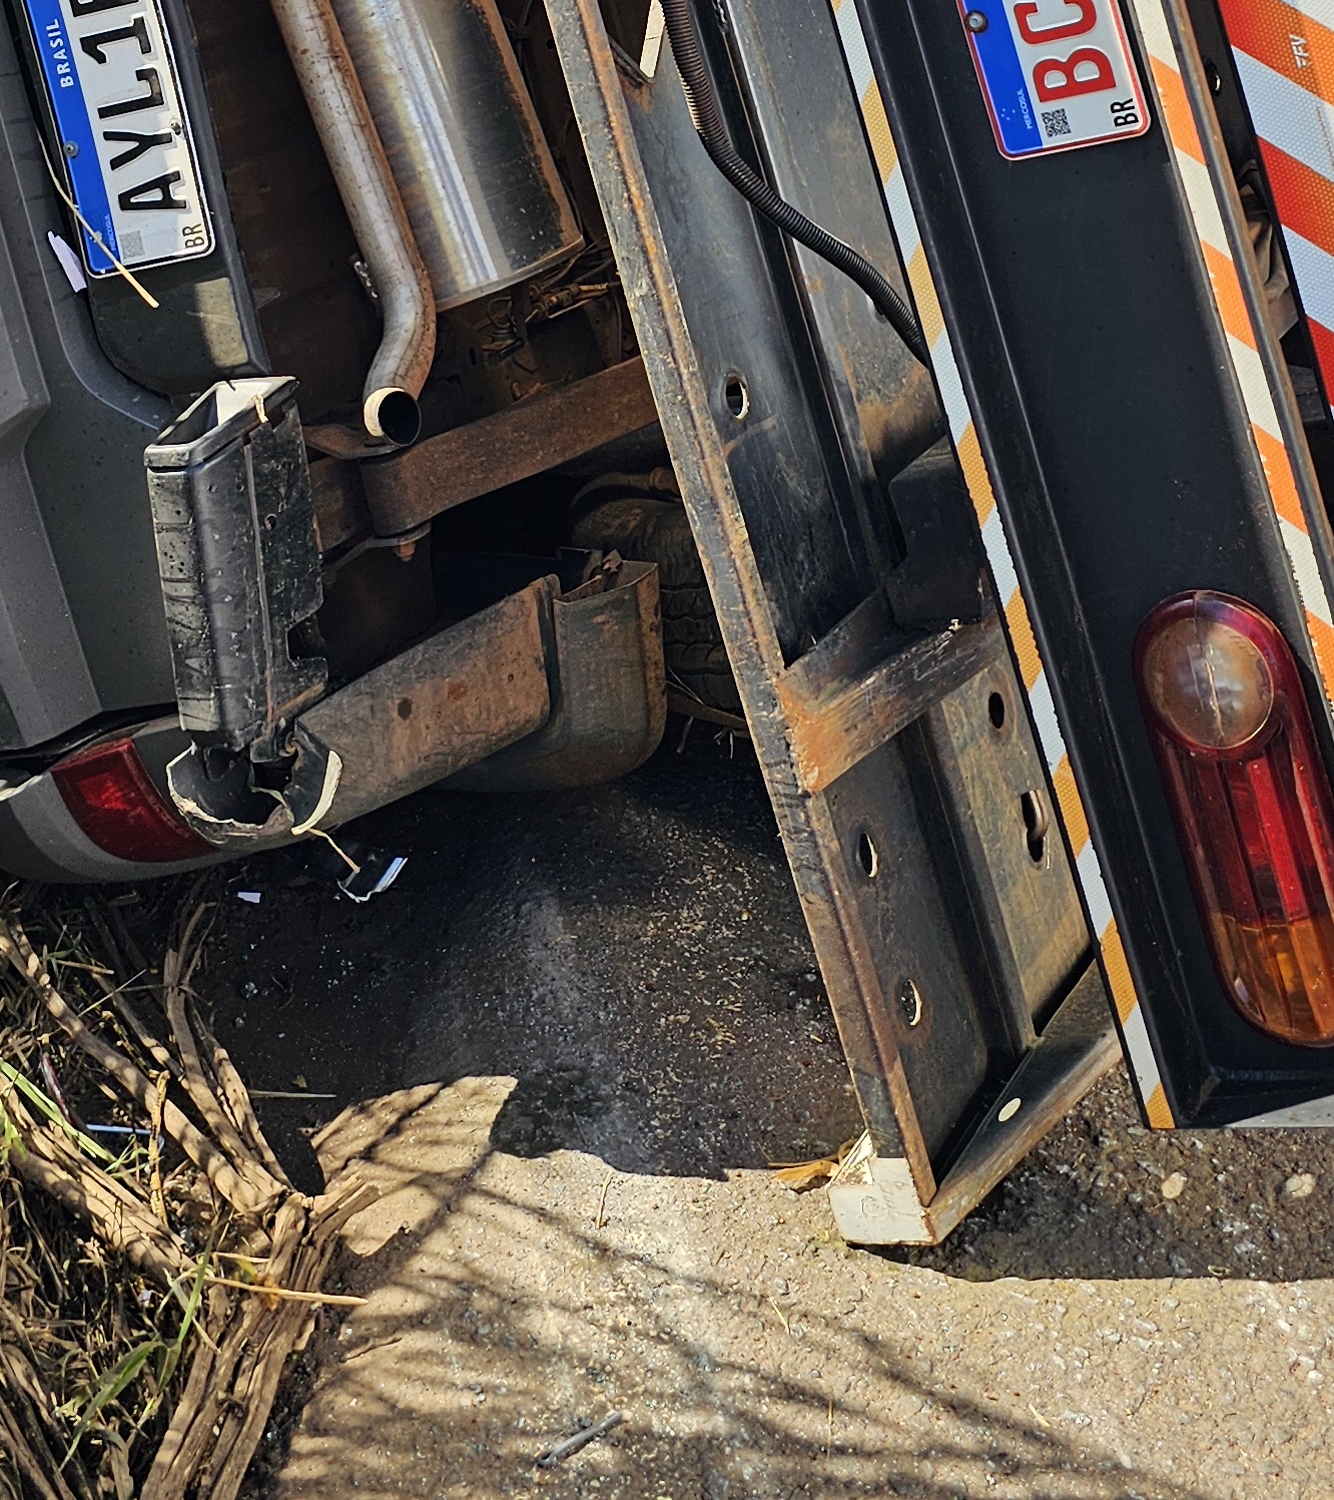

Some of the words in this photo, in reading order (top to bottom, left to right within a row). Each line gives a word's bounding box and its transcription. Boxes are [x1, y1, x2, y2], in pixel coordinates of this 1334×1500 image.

[45, 18, 73, 88] BRASIL
[1016, 88, 1033, 129] MERCOSUL
[1110, 98, 1139, 127] BR
[182, 223, 204, 248] BR
